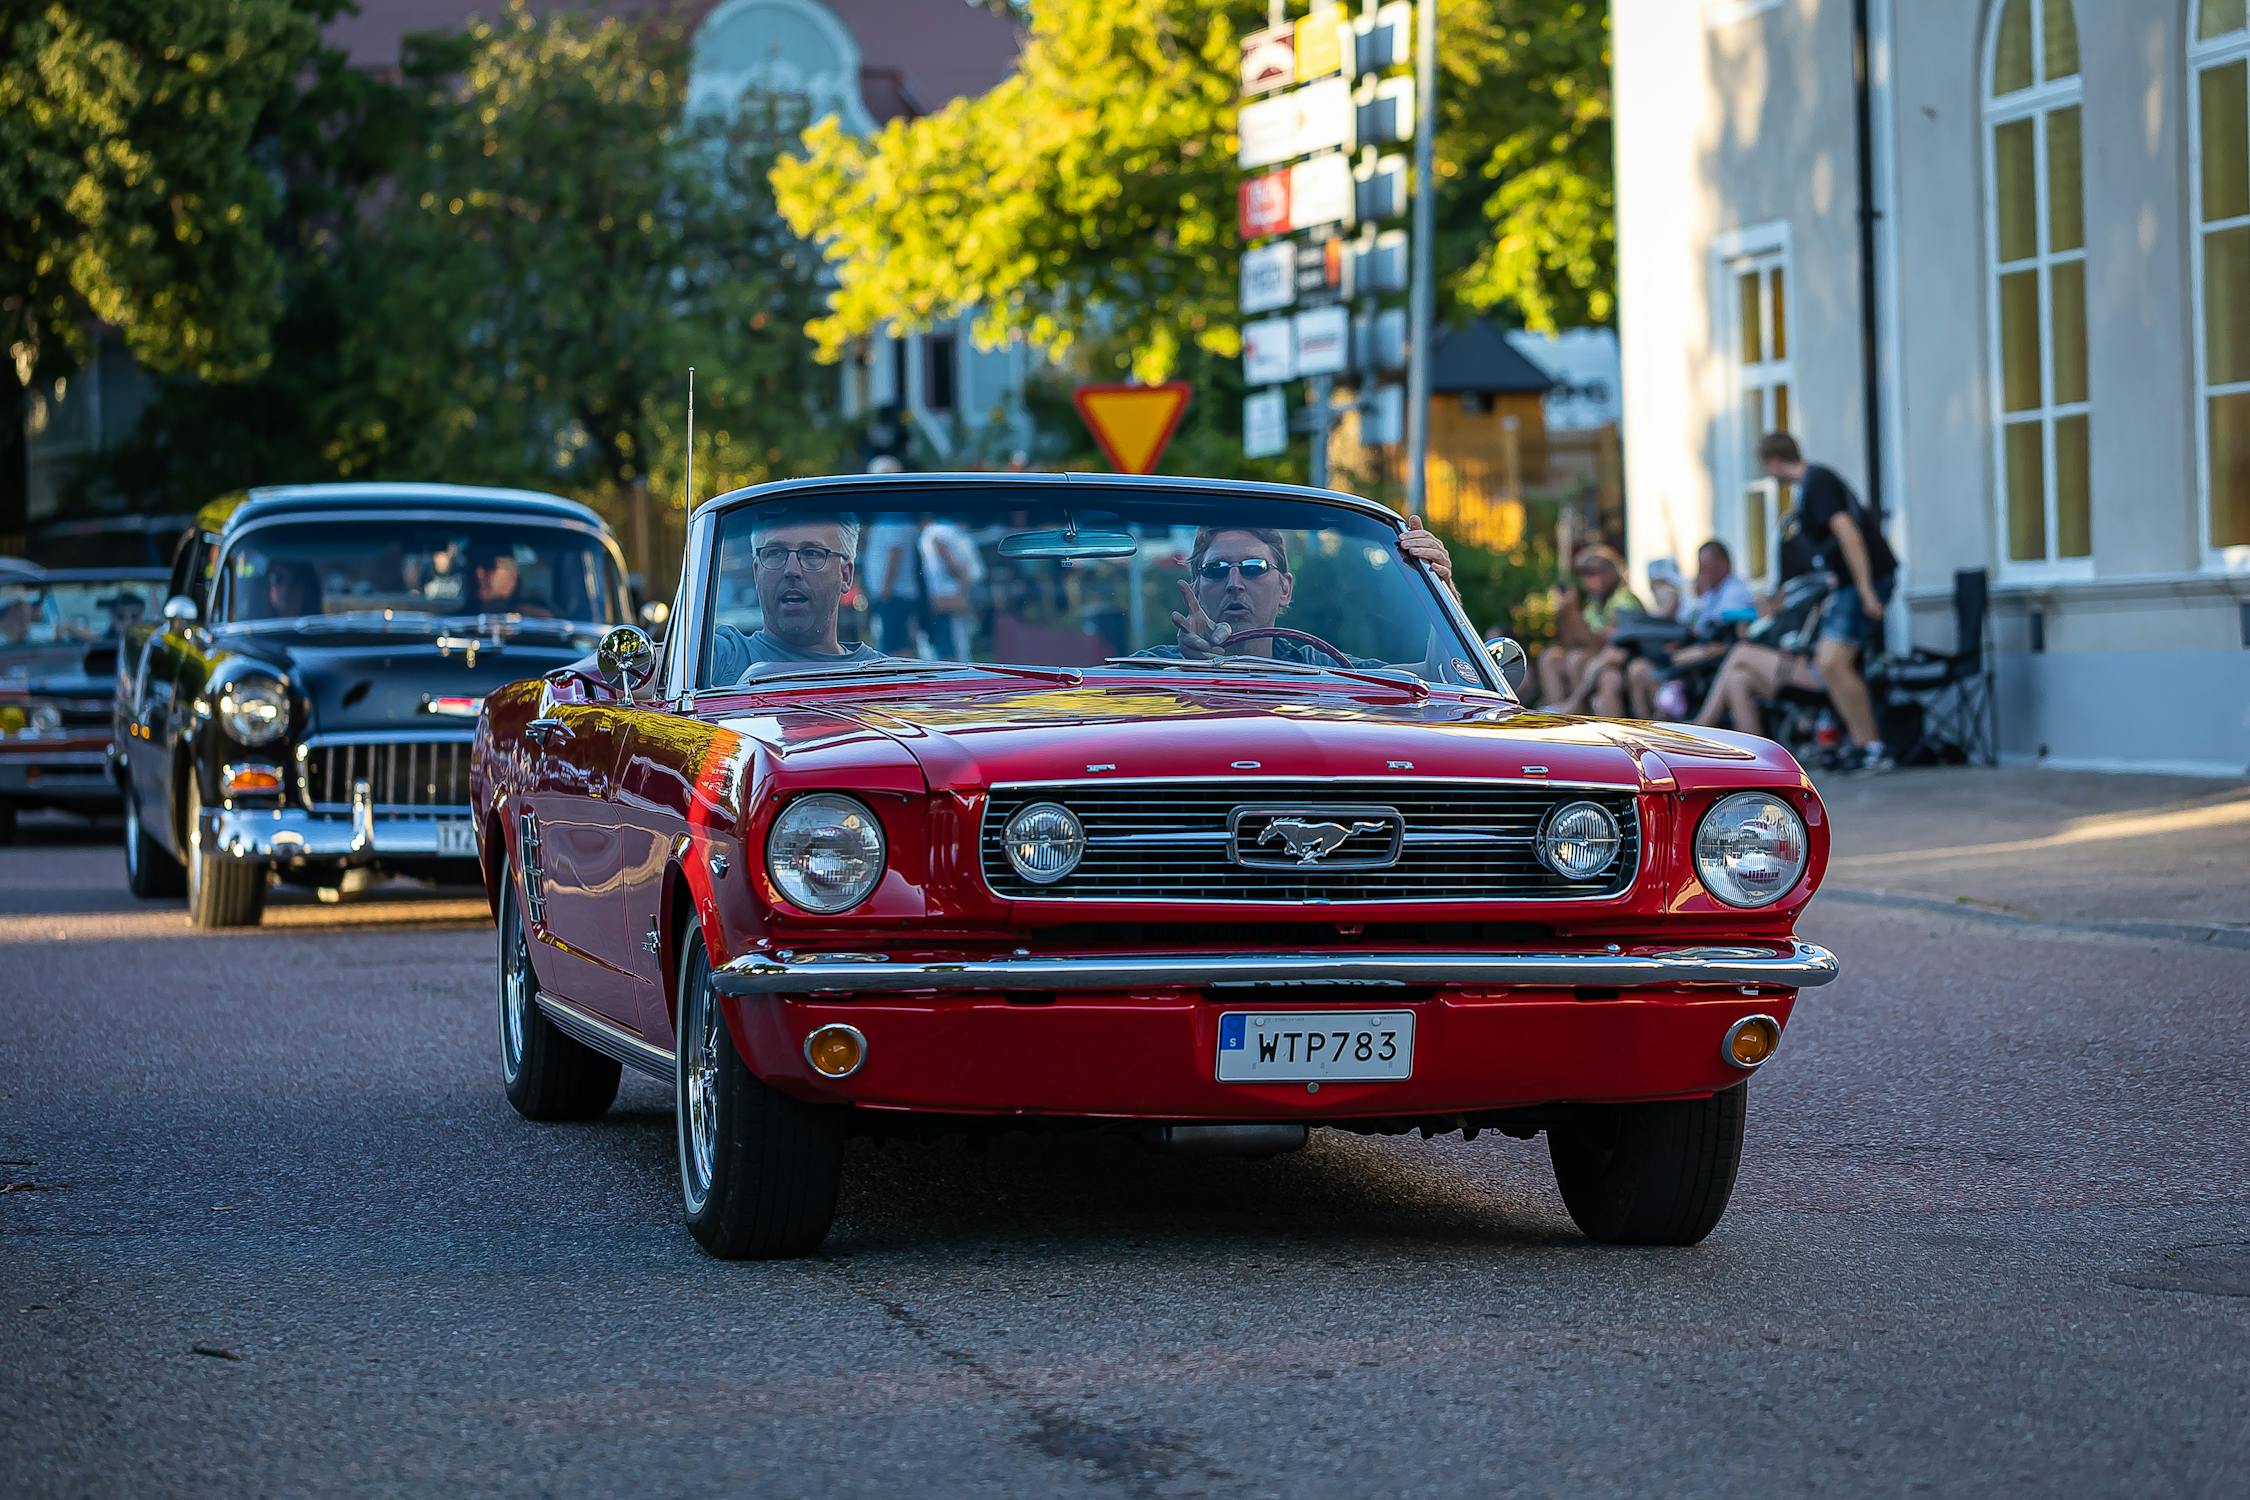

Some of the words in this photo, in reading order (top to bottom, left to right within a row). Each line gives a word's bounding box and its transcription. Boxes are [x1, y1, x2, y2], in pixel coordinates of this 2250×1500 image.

[1086, 760, 1549, 775] FORD
[1229, 1037, 1237, 1048] S
[1258, 1031, 1397, 1062] WTP783
